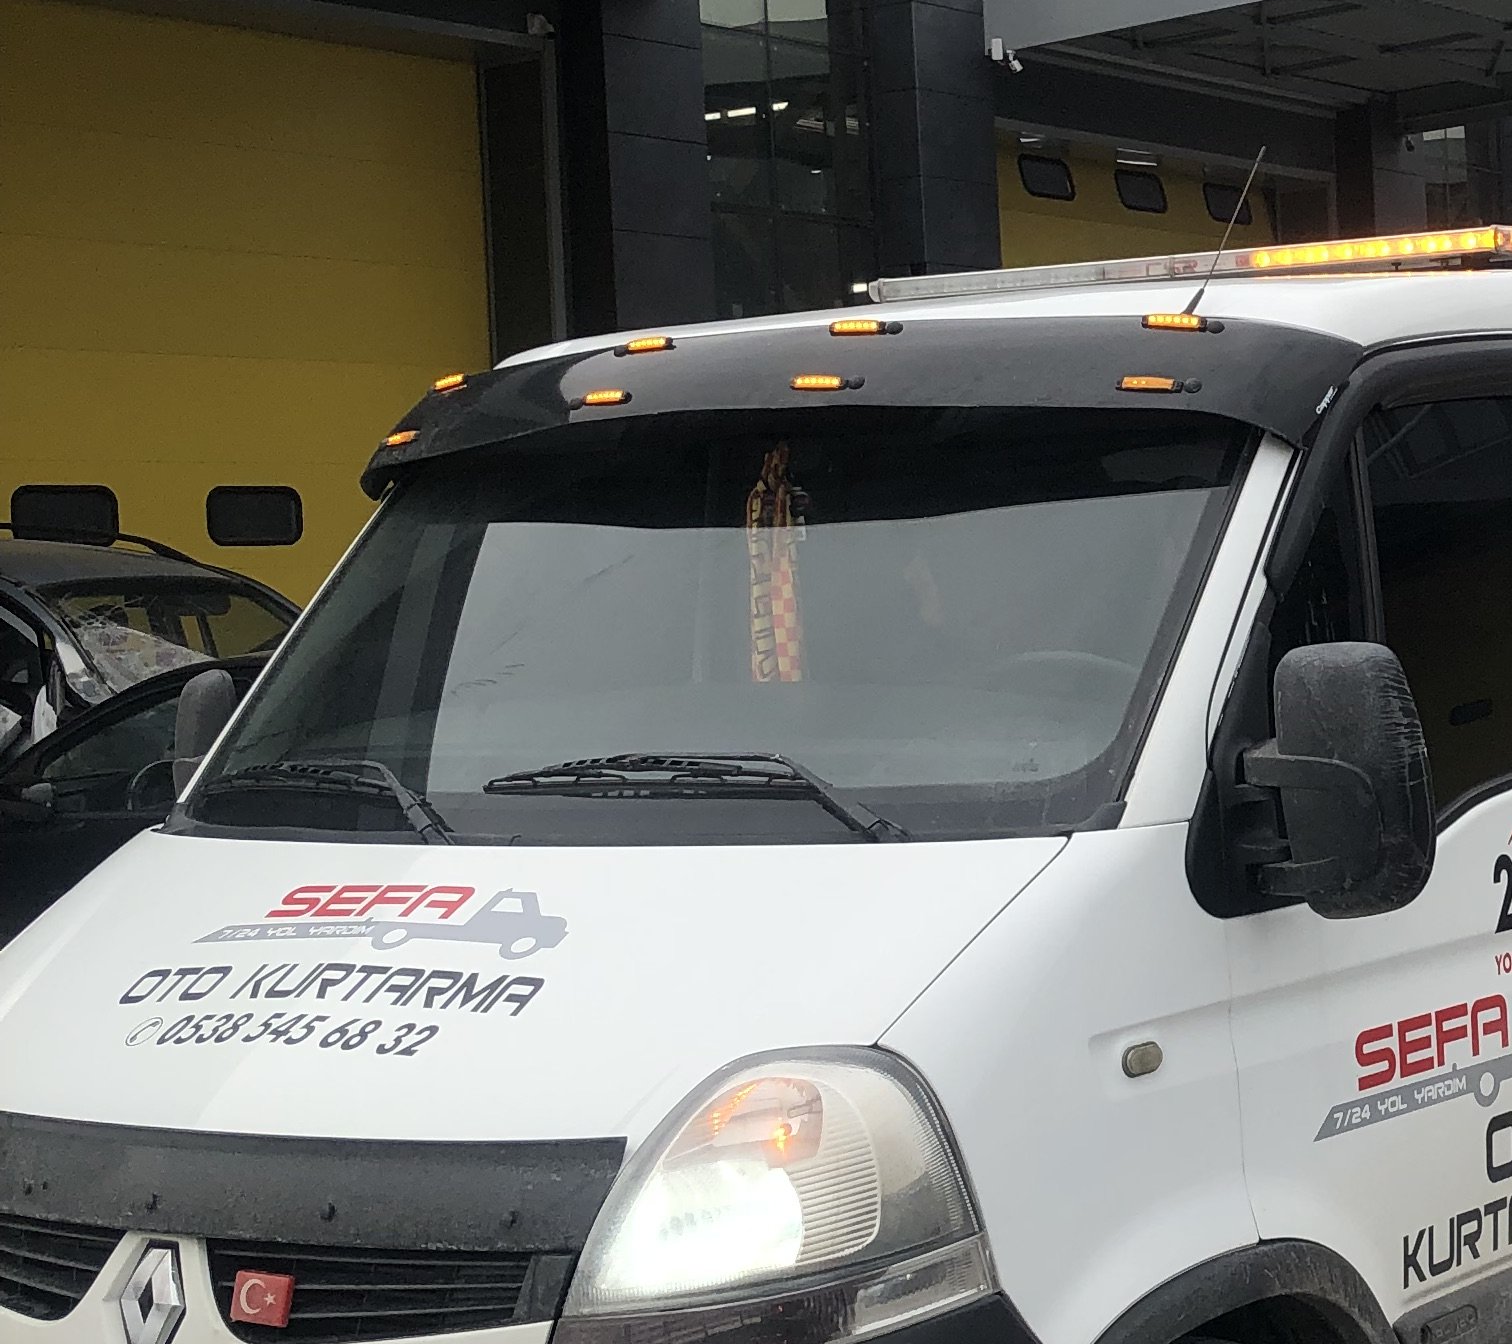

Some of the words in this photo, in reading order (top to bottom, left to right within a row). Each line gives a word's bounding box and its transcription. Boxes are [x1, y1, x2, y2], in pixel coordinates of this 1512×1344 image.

[264, 884, 475, 919] SEFA
[218, 925, 258, 940] 7/24
[266, 924, 298, 938] YOL
[308, 923, 376, 937] YARDIM
[119, 966, 233, 1005] OTO
[229, 963, 545, 1017] KURTARMA
[156, 1013, 254, 1046] 0538
[241, 1012, 320, 1046] 545
[318, 1019, 383, 1051] 68
[376, 1023, 440, 1056] 32
[1355, 994, 1509, 1091] SEFA
[1333, 1104, 1371, 1130] 7/24
[1377, 1094, 1407, 1116] YOL
[1414, 1075, 1467, 1104] YARDIM
